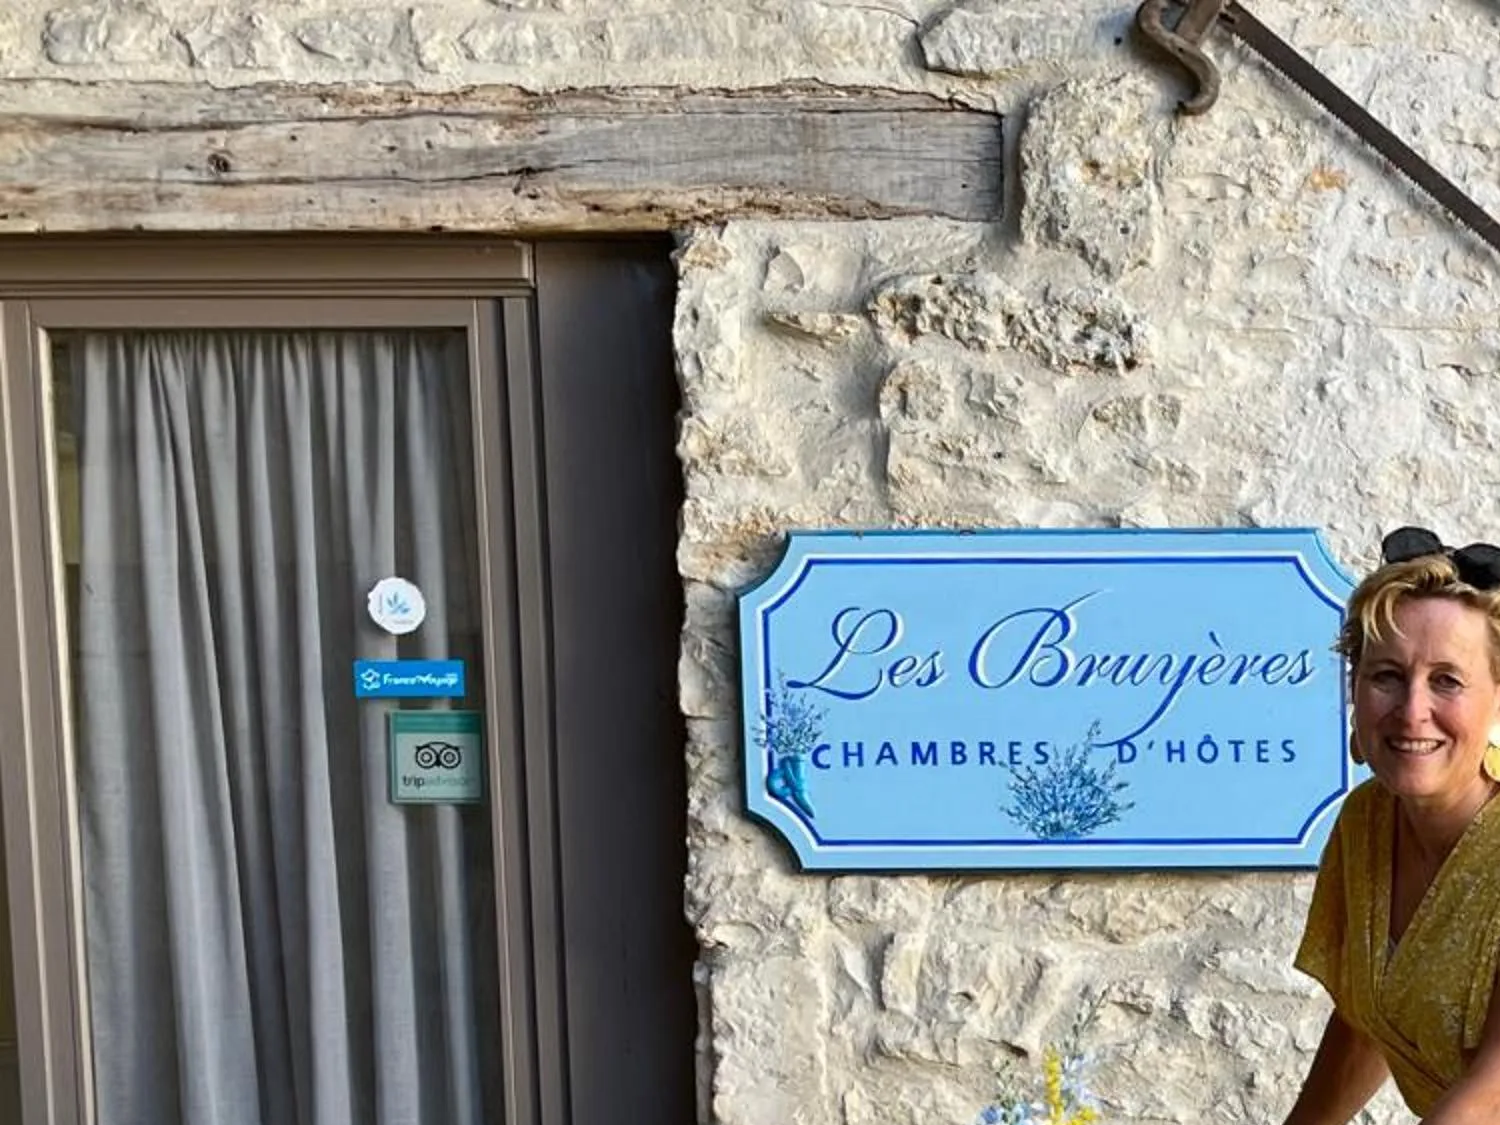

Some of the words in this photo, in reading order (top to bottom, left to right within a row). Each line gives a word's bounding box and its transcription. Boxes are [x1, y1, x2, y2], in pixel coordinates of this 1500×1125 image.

[786, 606, 945, 701] Les
[967, 588, 1316, 749] Bruyères
[810, 740, 1050, 770] CHAMBRES
[1116, 733, 1297, 765] D'HÔTES
[402, 775, 477, 789] tripad
